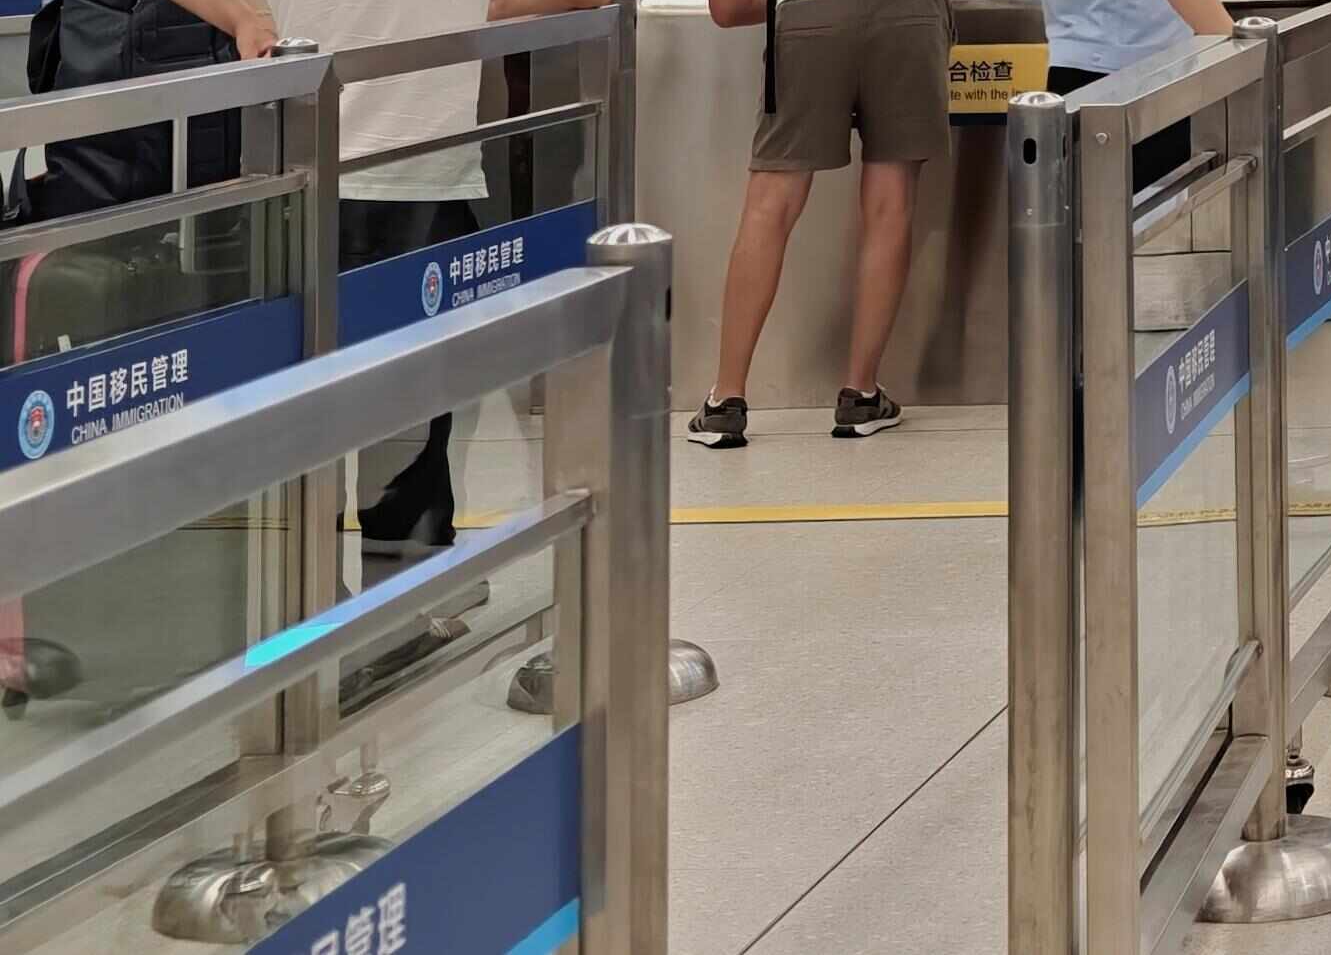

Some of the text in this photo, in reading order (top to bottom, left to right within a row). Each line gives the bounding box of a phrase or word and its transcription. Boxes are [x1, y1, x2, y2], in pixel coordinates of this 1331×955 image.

[948, 60, 1013, 83] 合检查
[964, 87, 987, 101] with
[990, 87, 1008, 101] the
[449, 236, 525, 286] 中国移民管理
[66, 348, 189, 418] 中国移民管理
[71, 391, 184, 445] CHINA IMMIGRATION
